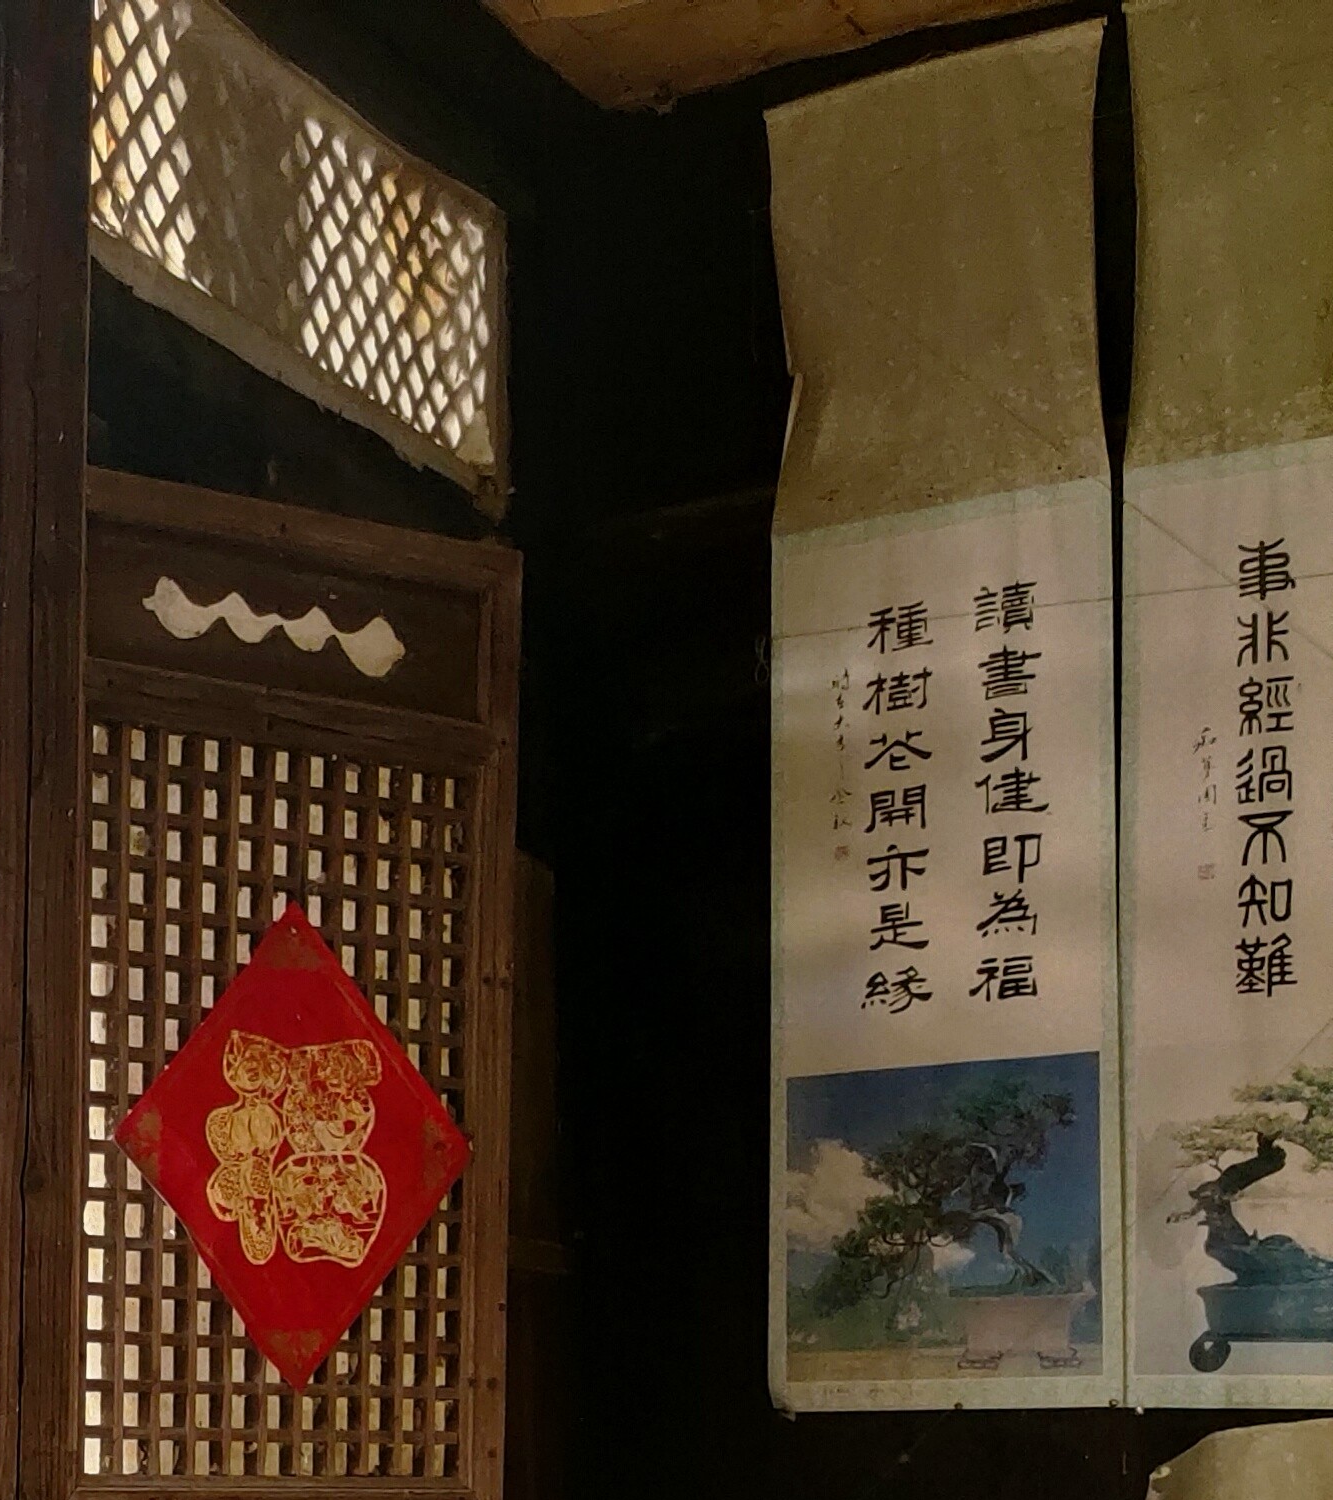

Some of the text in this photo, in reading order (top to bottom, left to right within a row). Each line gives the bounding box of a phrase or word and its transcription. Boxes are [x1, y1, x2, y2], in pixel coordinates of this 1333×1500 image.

[970, 581, 1049, 1002] 讀書身健即為福
[1236, 538, 1298, 998] 事非經過不知難
[205, 1029, 387, 1269] 福
